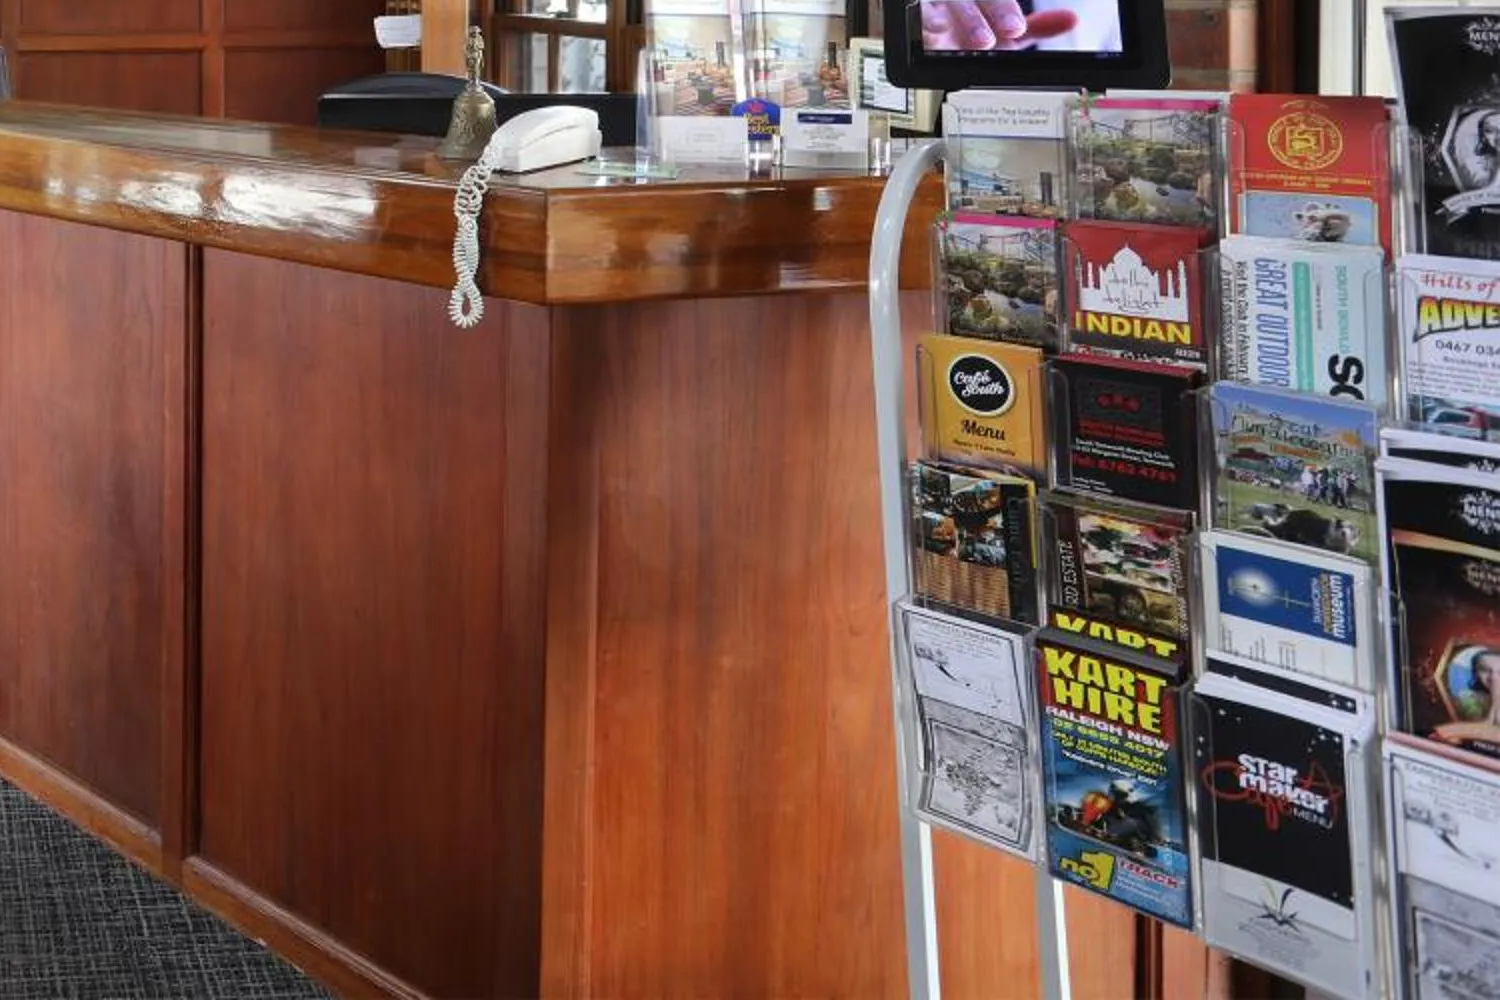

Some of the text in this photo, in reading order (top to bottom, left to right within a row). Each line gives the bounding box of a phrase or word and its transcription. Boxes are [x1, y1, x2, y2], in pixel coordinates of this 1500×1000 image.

[1253, 257, 1288, 311] GREAT
[1075, 311, 1191, 345] INDIAN
[961, 380, 1004, 397] South
[961, 419, 1005, 440] Menu
[1330, 575, 1346, 639] museum
[1043, 646, 1167, 705] KART
[1045, 705, 1171, 751] RALEIGH NSW
[1052, 676, 1162, 734] HIRE
